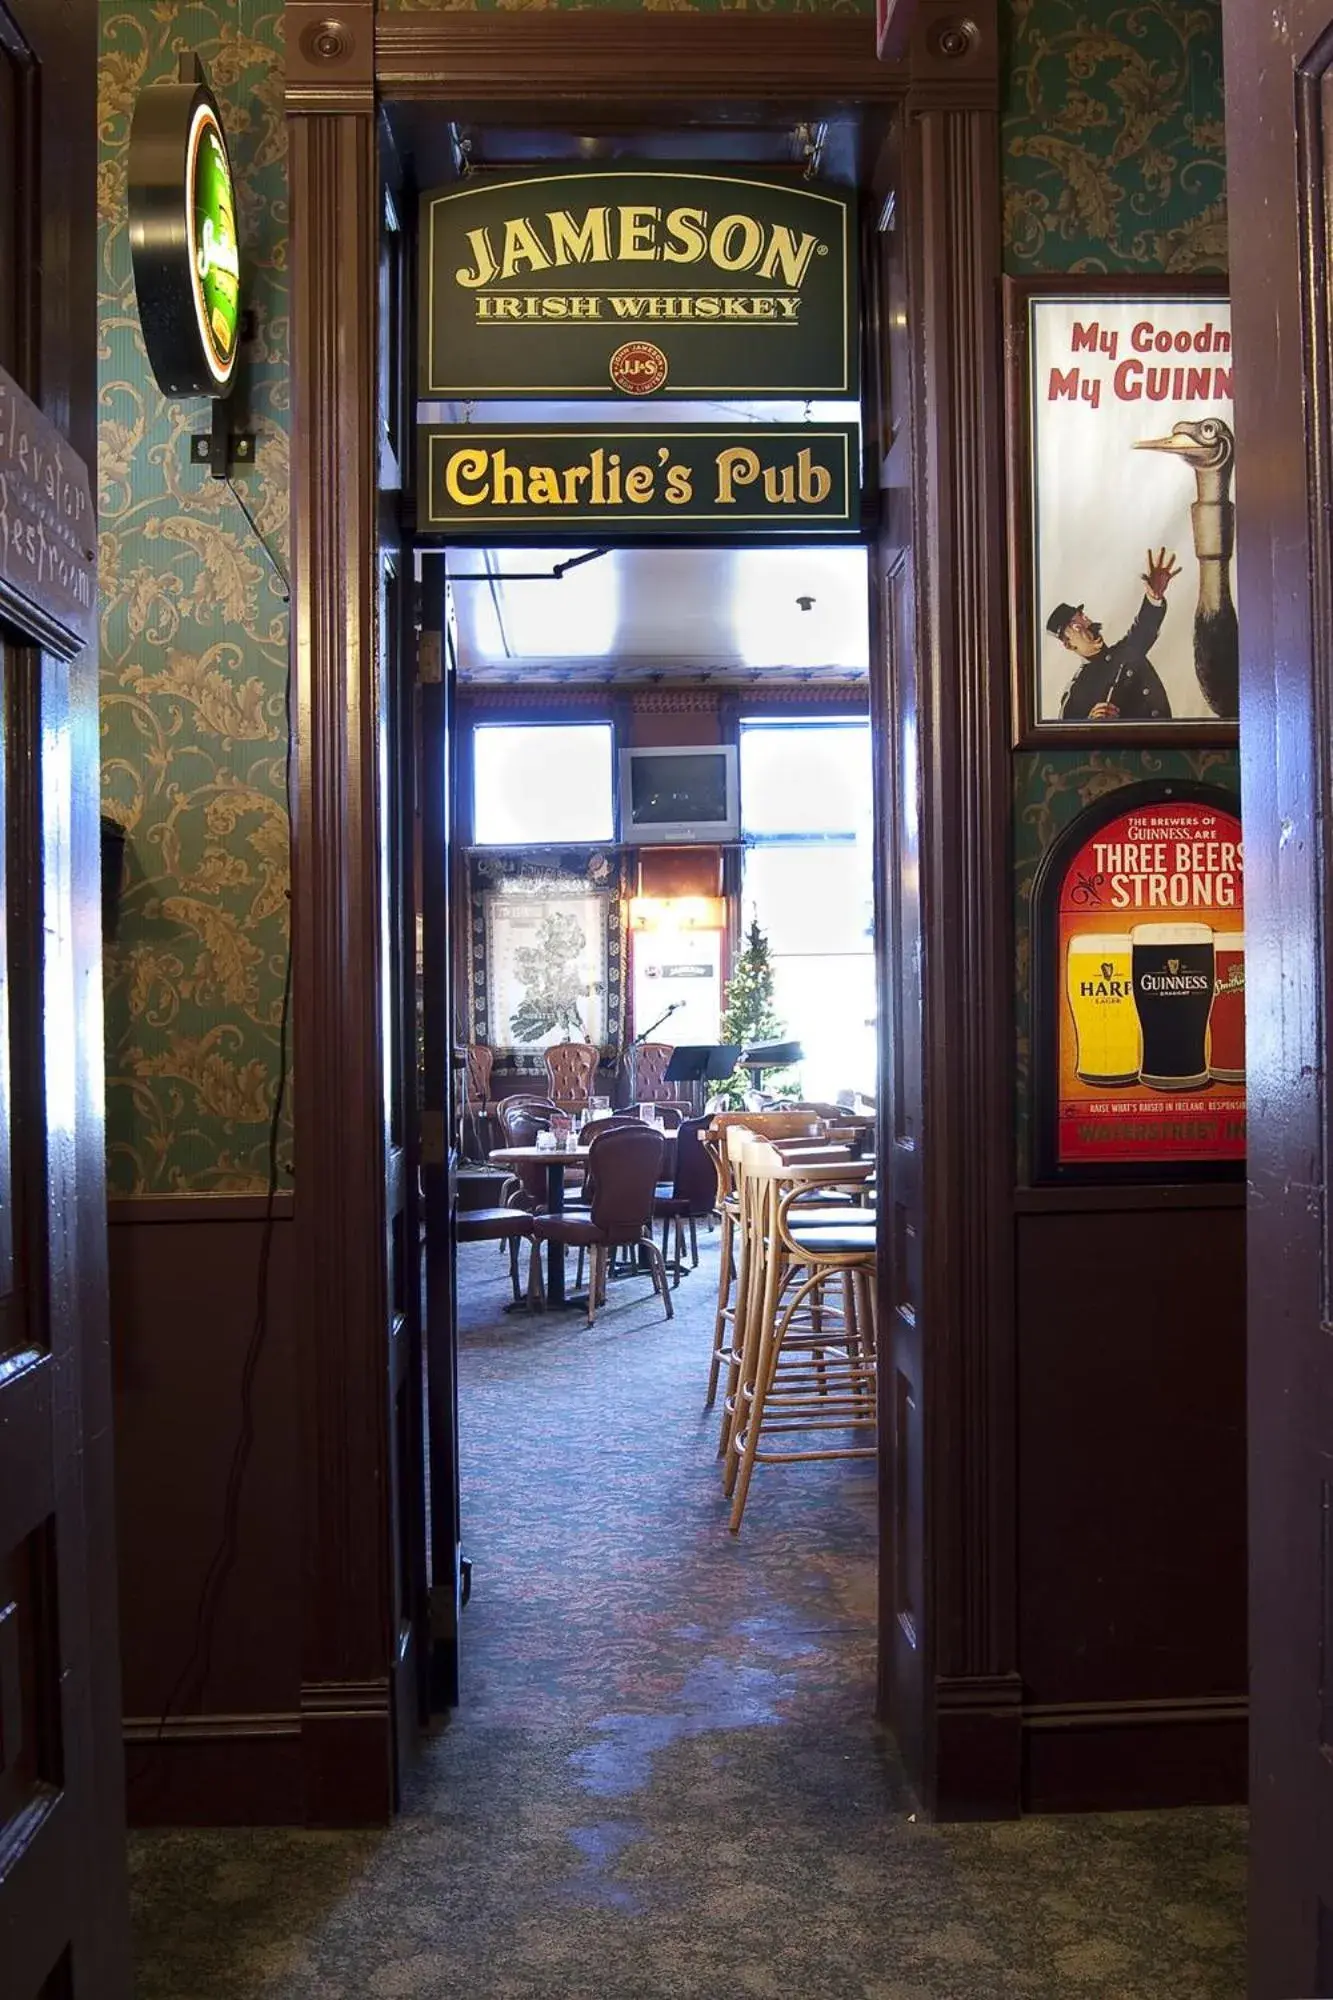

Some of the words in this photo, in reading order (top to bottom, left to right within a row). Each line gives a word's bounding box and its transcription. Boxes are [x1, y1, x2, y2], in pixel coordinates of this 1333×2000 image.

[475, 296, 602, 319] IRISH
[607, 296, 803, 319] WHISKEY
[1071, 321, 1119, 361] My
[1047, 367, 1102, 409] My
[444, 446, 693, 506] Charlie's
[714, 446, 833, 505] Pub
[1127, 817, 1147, 826] THE
[1150, 816, 1199, 826] BREWERS
[1202, 815, 1217, 825] OF
[1194, 830, 1217, 840] ARE
[1093, 843, 1167, 873] THREE
[1111, 873, 1235, 908] STRONG
[1140, 974, 1208, 991] GUINNESS
[1111, 1103, 1137, 1113] WHAT'S
[1139, 1103, 1164, 1112] RAISED
[1165, 1102, 1172, 1111] IN
